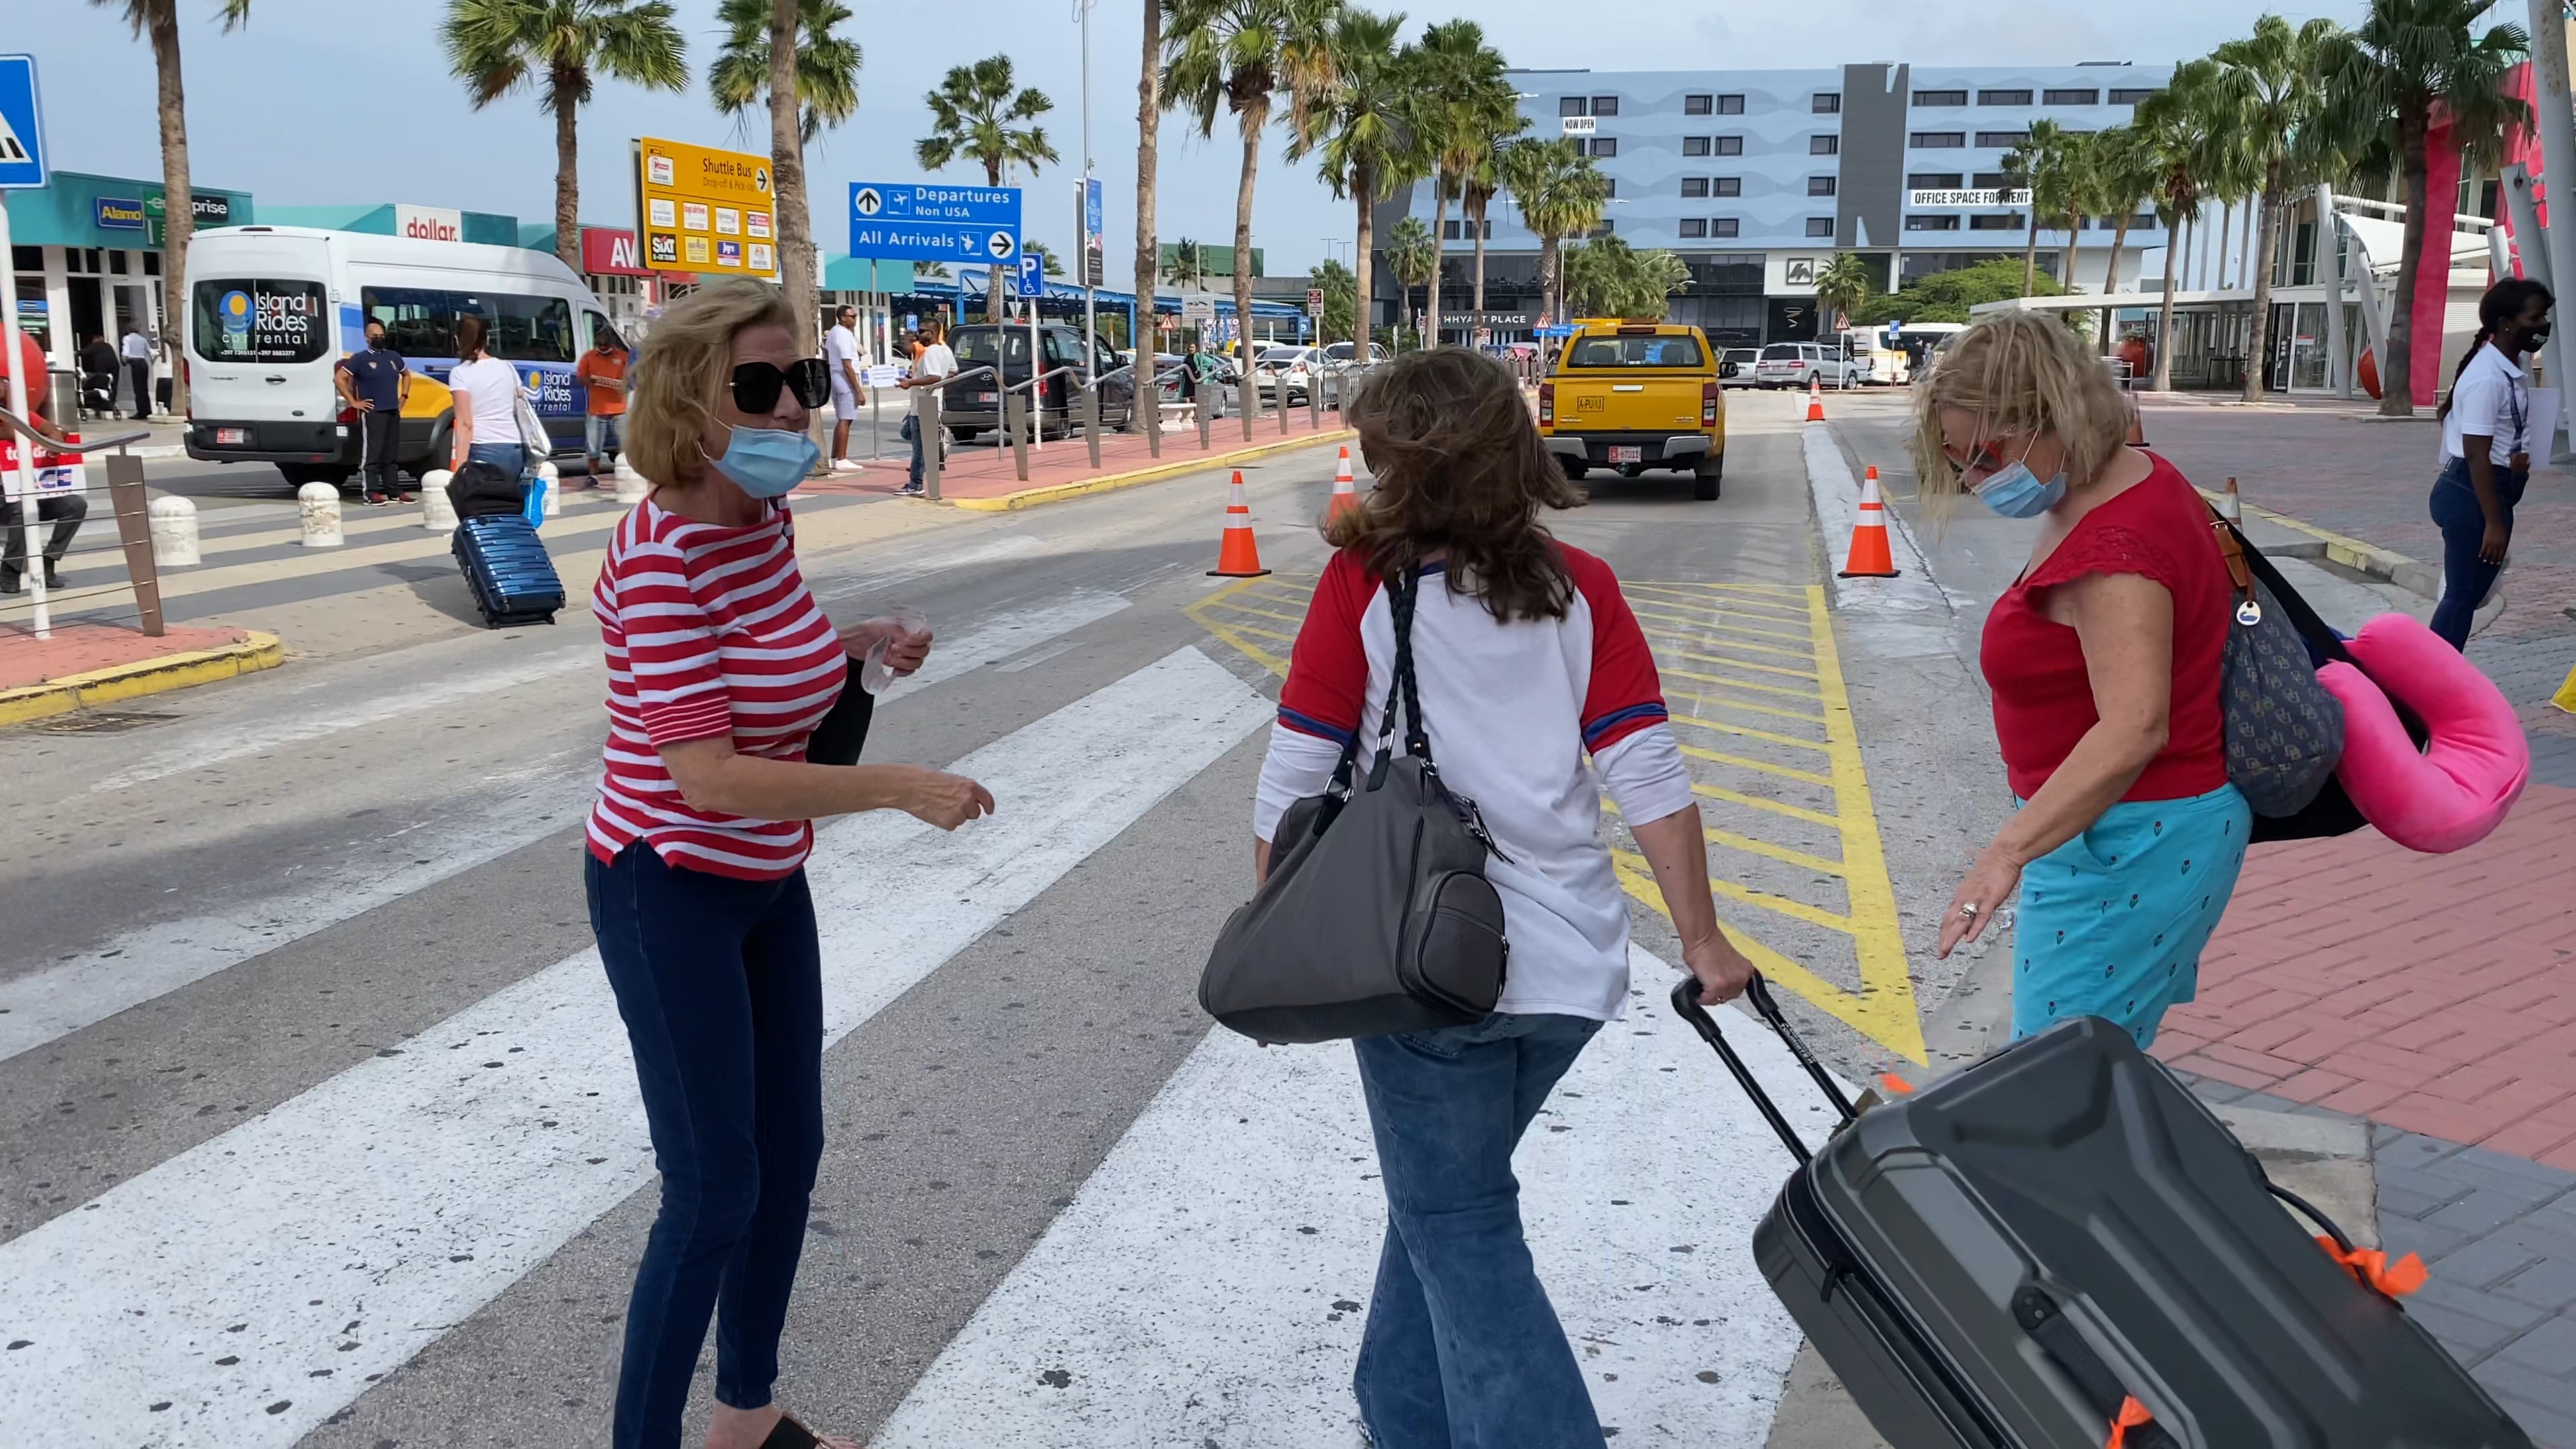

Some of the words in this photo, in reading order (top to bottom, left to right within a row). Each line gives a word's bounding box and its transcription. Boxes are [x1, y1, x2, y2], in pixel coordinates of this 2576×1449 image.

[1565, 119, 1578, 129] NOW
[1580, 119, 1595, 129] OPEN
[703, 158, 734, 176] Shuttle
[737, 163, 751, 177] Bus
[703, 177, 727, 190] Drop-off
[916, 187, 1010, 204] Departures
[1915, 192, 1946, 204] OFFICE
[1950, 192, 1980, 204] SPACE
[2007, 192, 2029, 203] ENT
[2284, 184, 2316, 208] Departure
[102, 206, 142, 221] Alamo
[146, 197, 227, 215] eprise
[916, 206, 939, 216] Non
[945, 207, 970, 217] USA
[859, 231, 881, 244] All
[889, 232, 955, 247] Arrivals
[610, 237, 635, 268] AV
[1022, 258, 1037, 279] P
[256, 292, 306, 311] Island
[256, 311, 307, 331] Rides
[222, 334, 248, 343] car
[256, 333, 307, 343] rental
[543, 371, 570, 386] Island
[544, 386, 572, 401] Rides
[543, 403, 570, 411] rental
